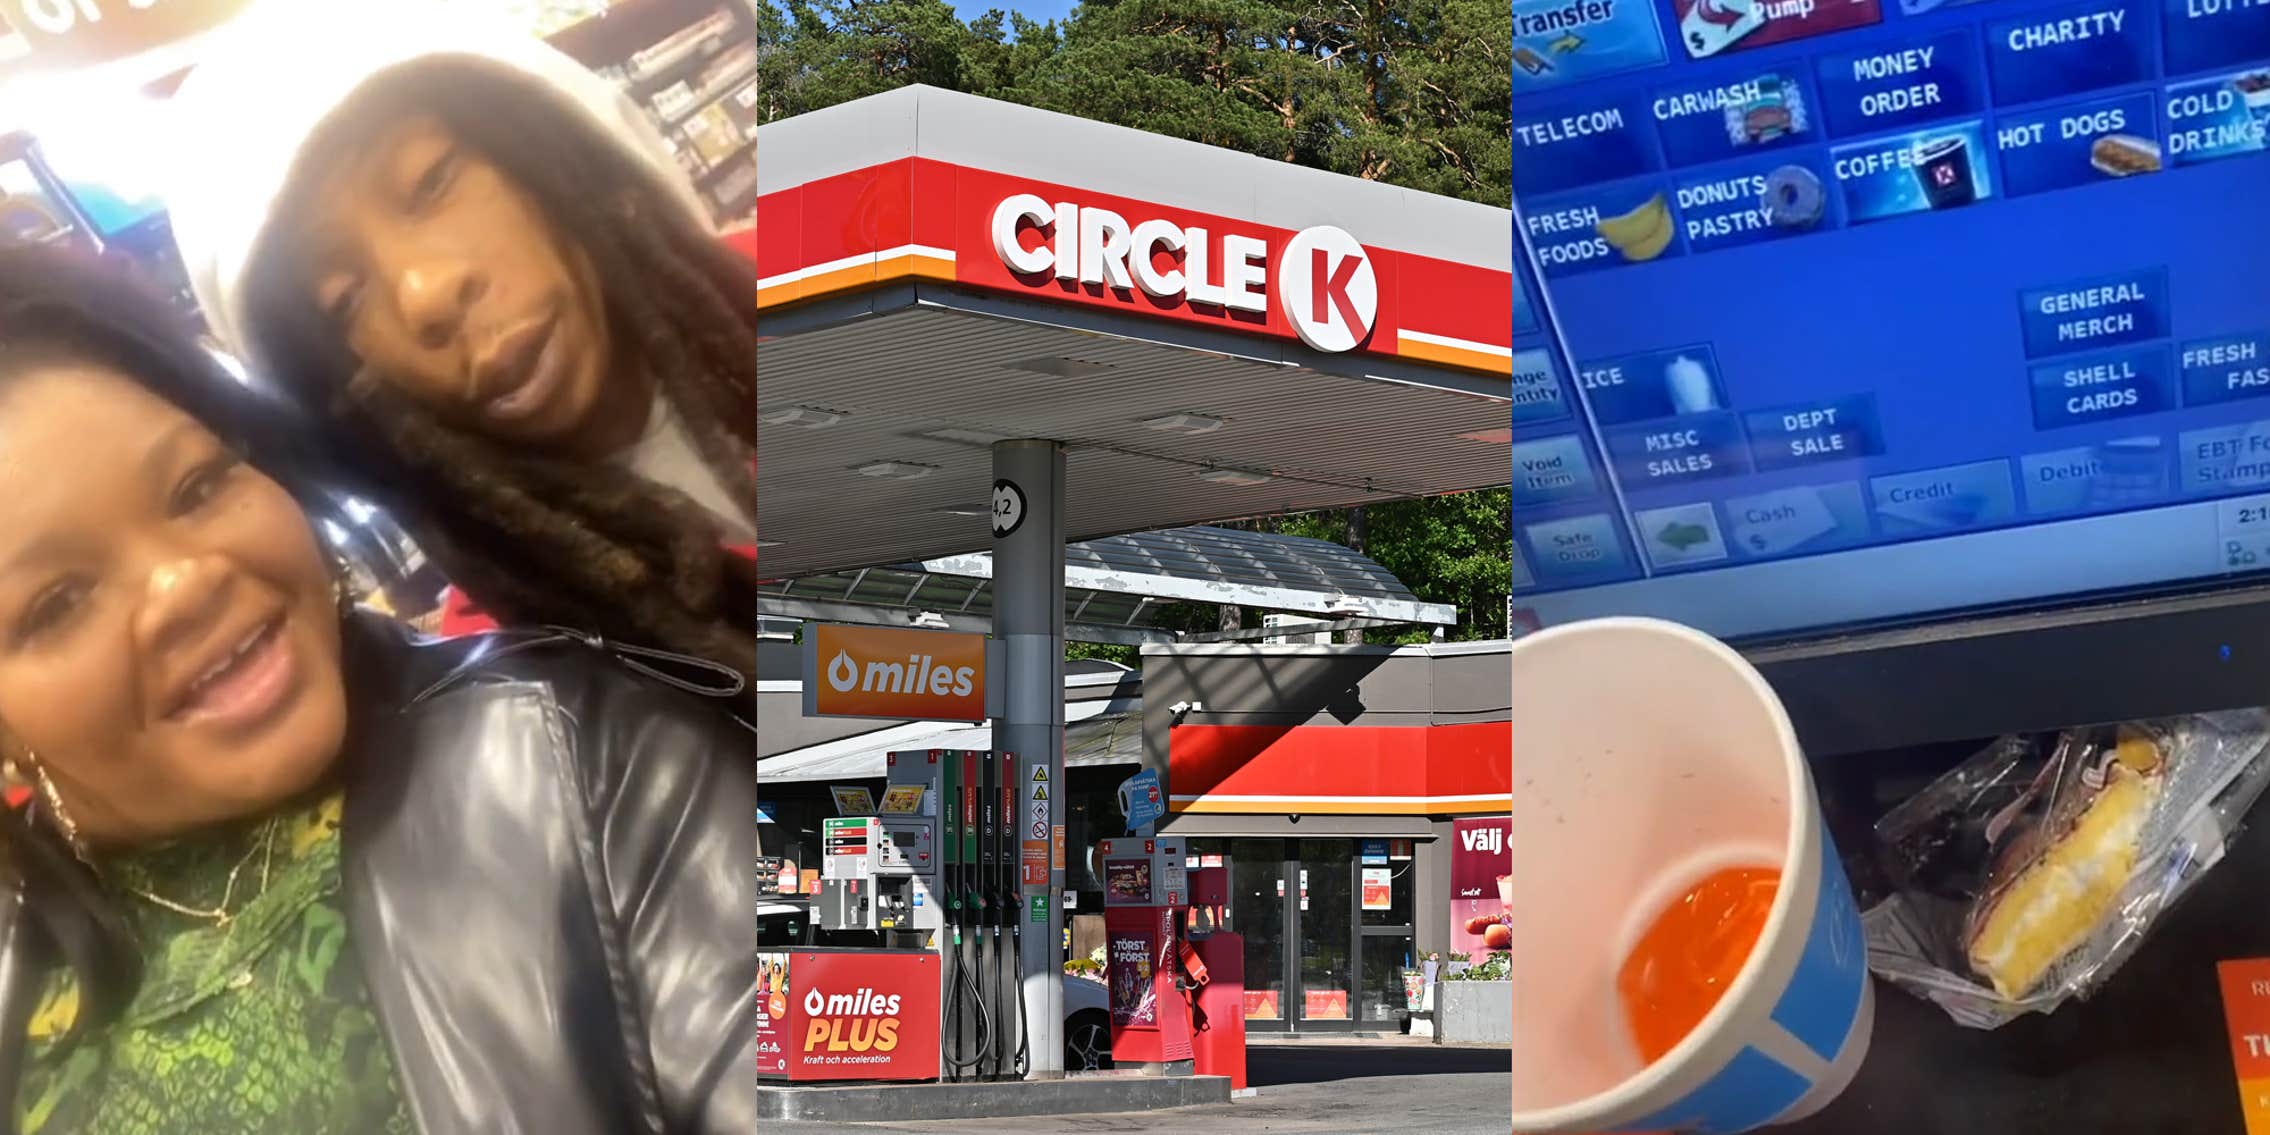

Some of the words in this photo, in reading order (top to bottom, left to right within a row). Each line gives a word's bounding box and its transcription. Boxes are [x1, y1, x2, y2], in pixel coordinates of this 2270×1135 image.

[1512, 0, 1613, 37] Transfer
[1752, 0, 1814, 22] Pump
[2009, 9, 2126, 51] CHARITY
[1854, 46, 1934, 82] MONEY
[1653, 81, 1762, 120] CARWASH
[1860, 83, 1941, 116] ORDER
[2167, 90, 2233, 119] COLD
[1516, 108, 1624, 146] TELECOM
[1998, 123, 2045, 151] HOT
[2061, 109, 2126, 140] DOGS
[2168, 119, 2266, 155] DRINKS
[1834, 140, 1927, 181] COFFEE
[1677, 175, 1768, 210] DONUTS
[1527, 206, 1600, 237] FRESH
[1687, 208, 1774, 241] PASTRY
[991, 194, 1267, 313] CIRCLE
[1538, 238, 1609, 267] FOODS
[2041, 282, 2145, 315] GENERAL
[2058, 313, 2133, 342] MERCH
[2182, 341, 2257, 369] FRESH
[1582, 367, 1625, 390] ICE
[2064, 362, 2136, 388] SHELL
[2067, 388, 2138, 414] CARDS
[1783, 408, 1838, 432] DEPT
[1645, 430, 1699, 452] MISC
[1790, 435, 1845, 457] SALE
[2197, 438, 2240, 460] EBT
[1522, 456, 1563, 472] Void
[1648, 454, 1713, 477] SALES
[2040, 461, 2100, 483] Debit
[1889, 481, 1955, 504] Credit
[1746, 502, 1796, 524] Cash
[2239, 505, 2270, 524] 2:1
[1553, 532, 1593, 547] Safe
[862, 655, 975, 697] miles
[1461, 828, 1503, 855] Välj
[1023, 865, 1030, 880] 1
[1116, 938, 1146, 951] TÖRST
[1120, 951, 1150, 963] FÖRST
[826, 988, 901, 1015] miles
[804, 1018, 900, 1051] PLUS
[803, 1055, 824, 1065] Kraft
[826, 1055, 841, 1065] och
[842, 1055, 891, 1064] acceleration
